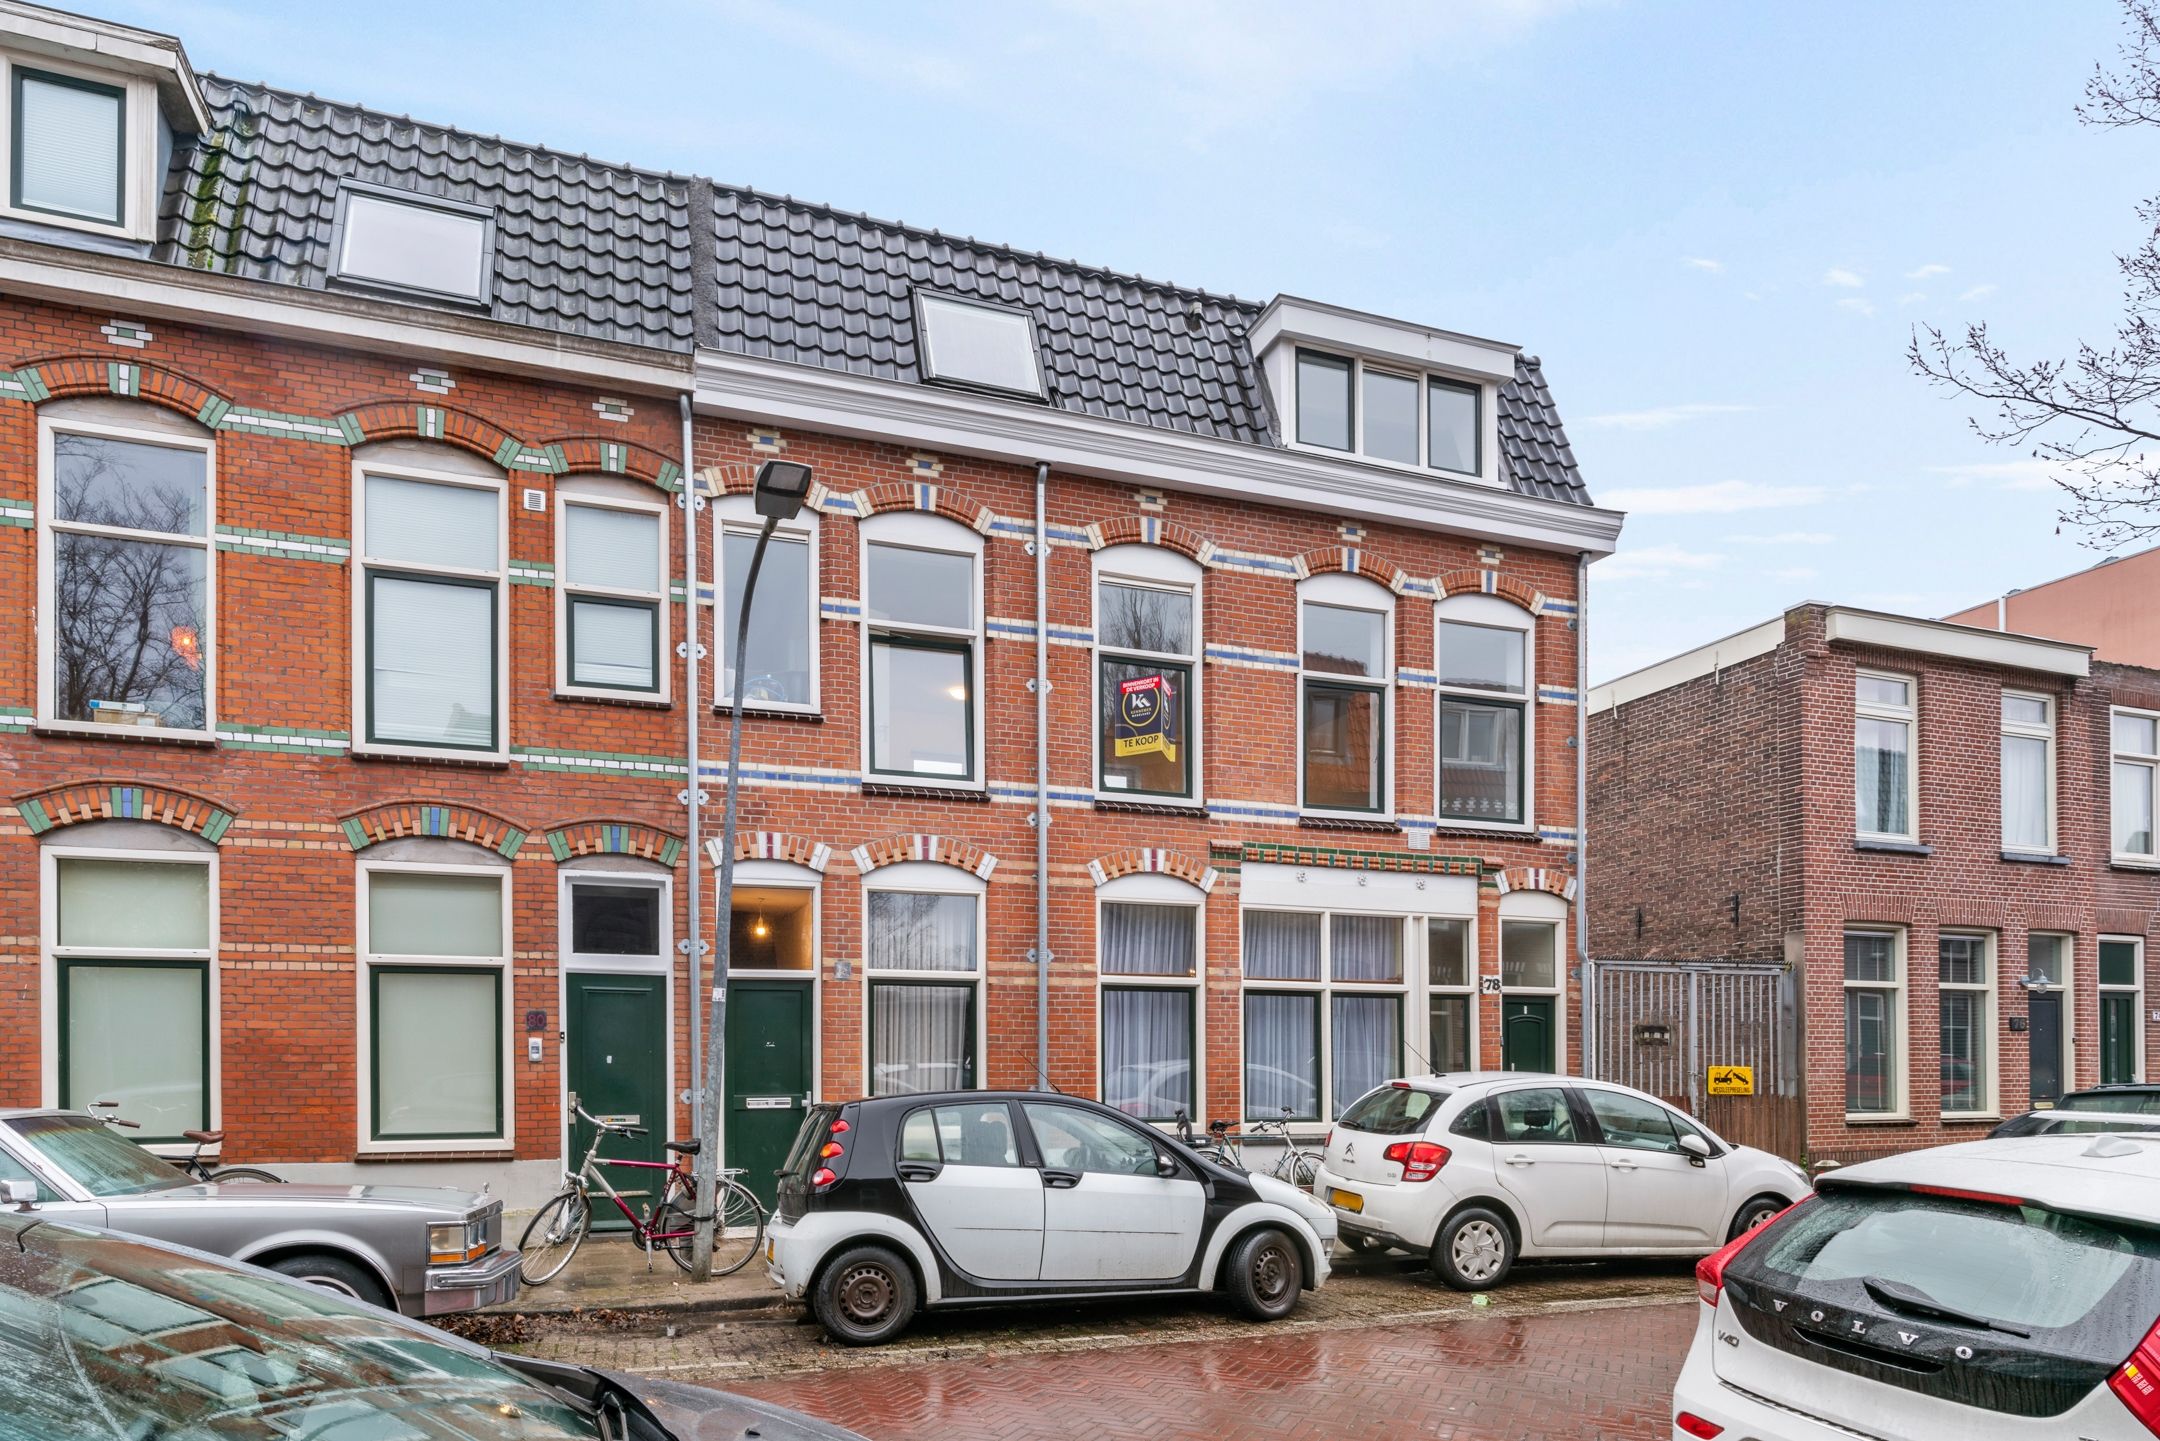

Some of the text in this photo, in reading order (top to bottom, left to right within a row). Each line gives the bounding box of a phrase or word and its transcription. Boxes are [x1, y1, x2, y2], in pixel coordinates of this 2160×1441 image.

[1123, 739, 1133, 748] TE
[1135, 735, 1159, 746] KOOP
[1484, 979, 1500, 991] 78
[528, 1014, 545, 1027] 80
[1773, 1299, 1973, 1360] VOLVO
[1718, 1329, 1739, 1347] V40
